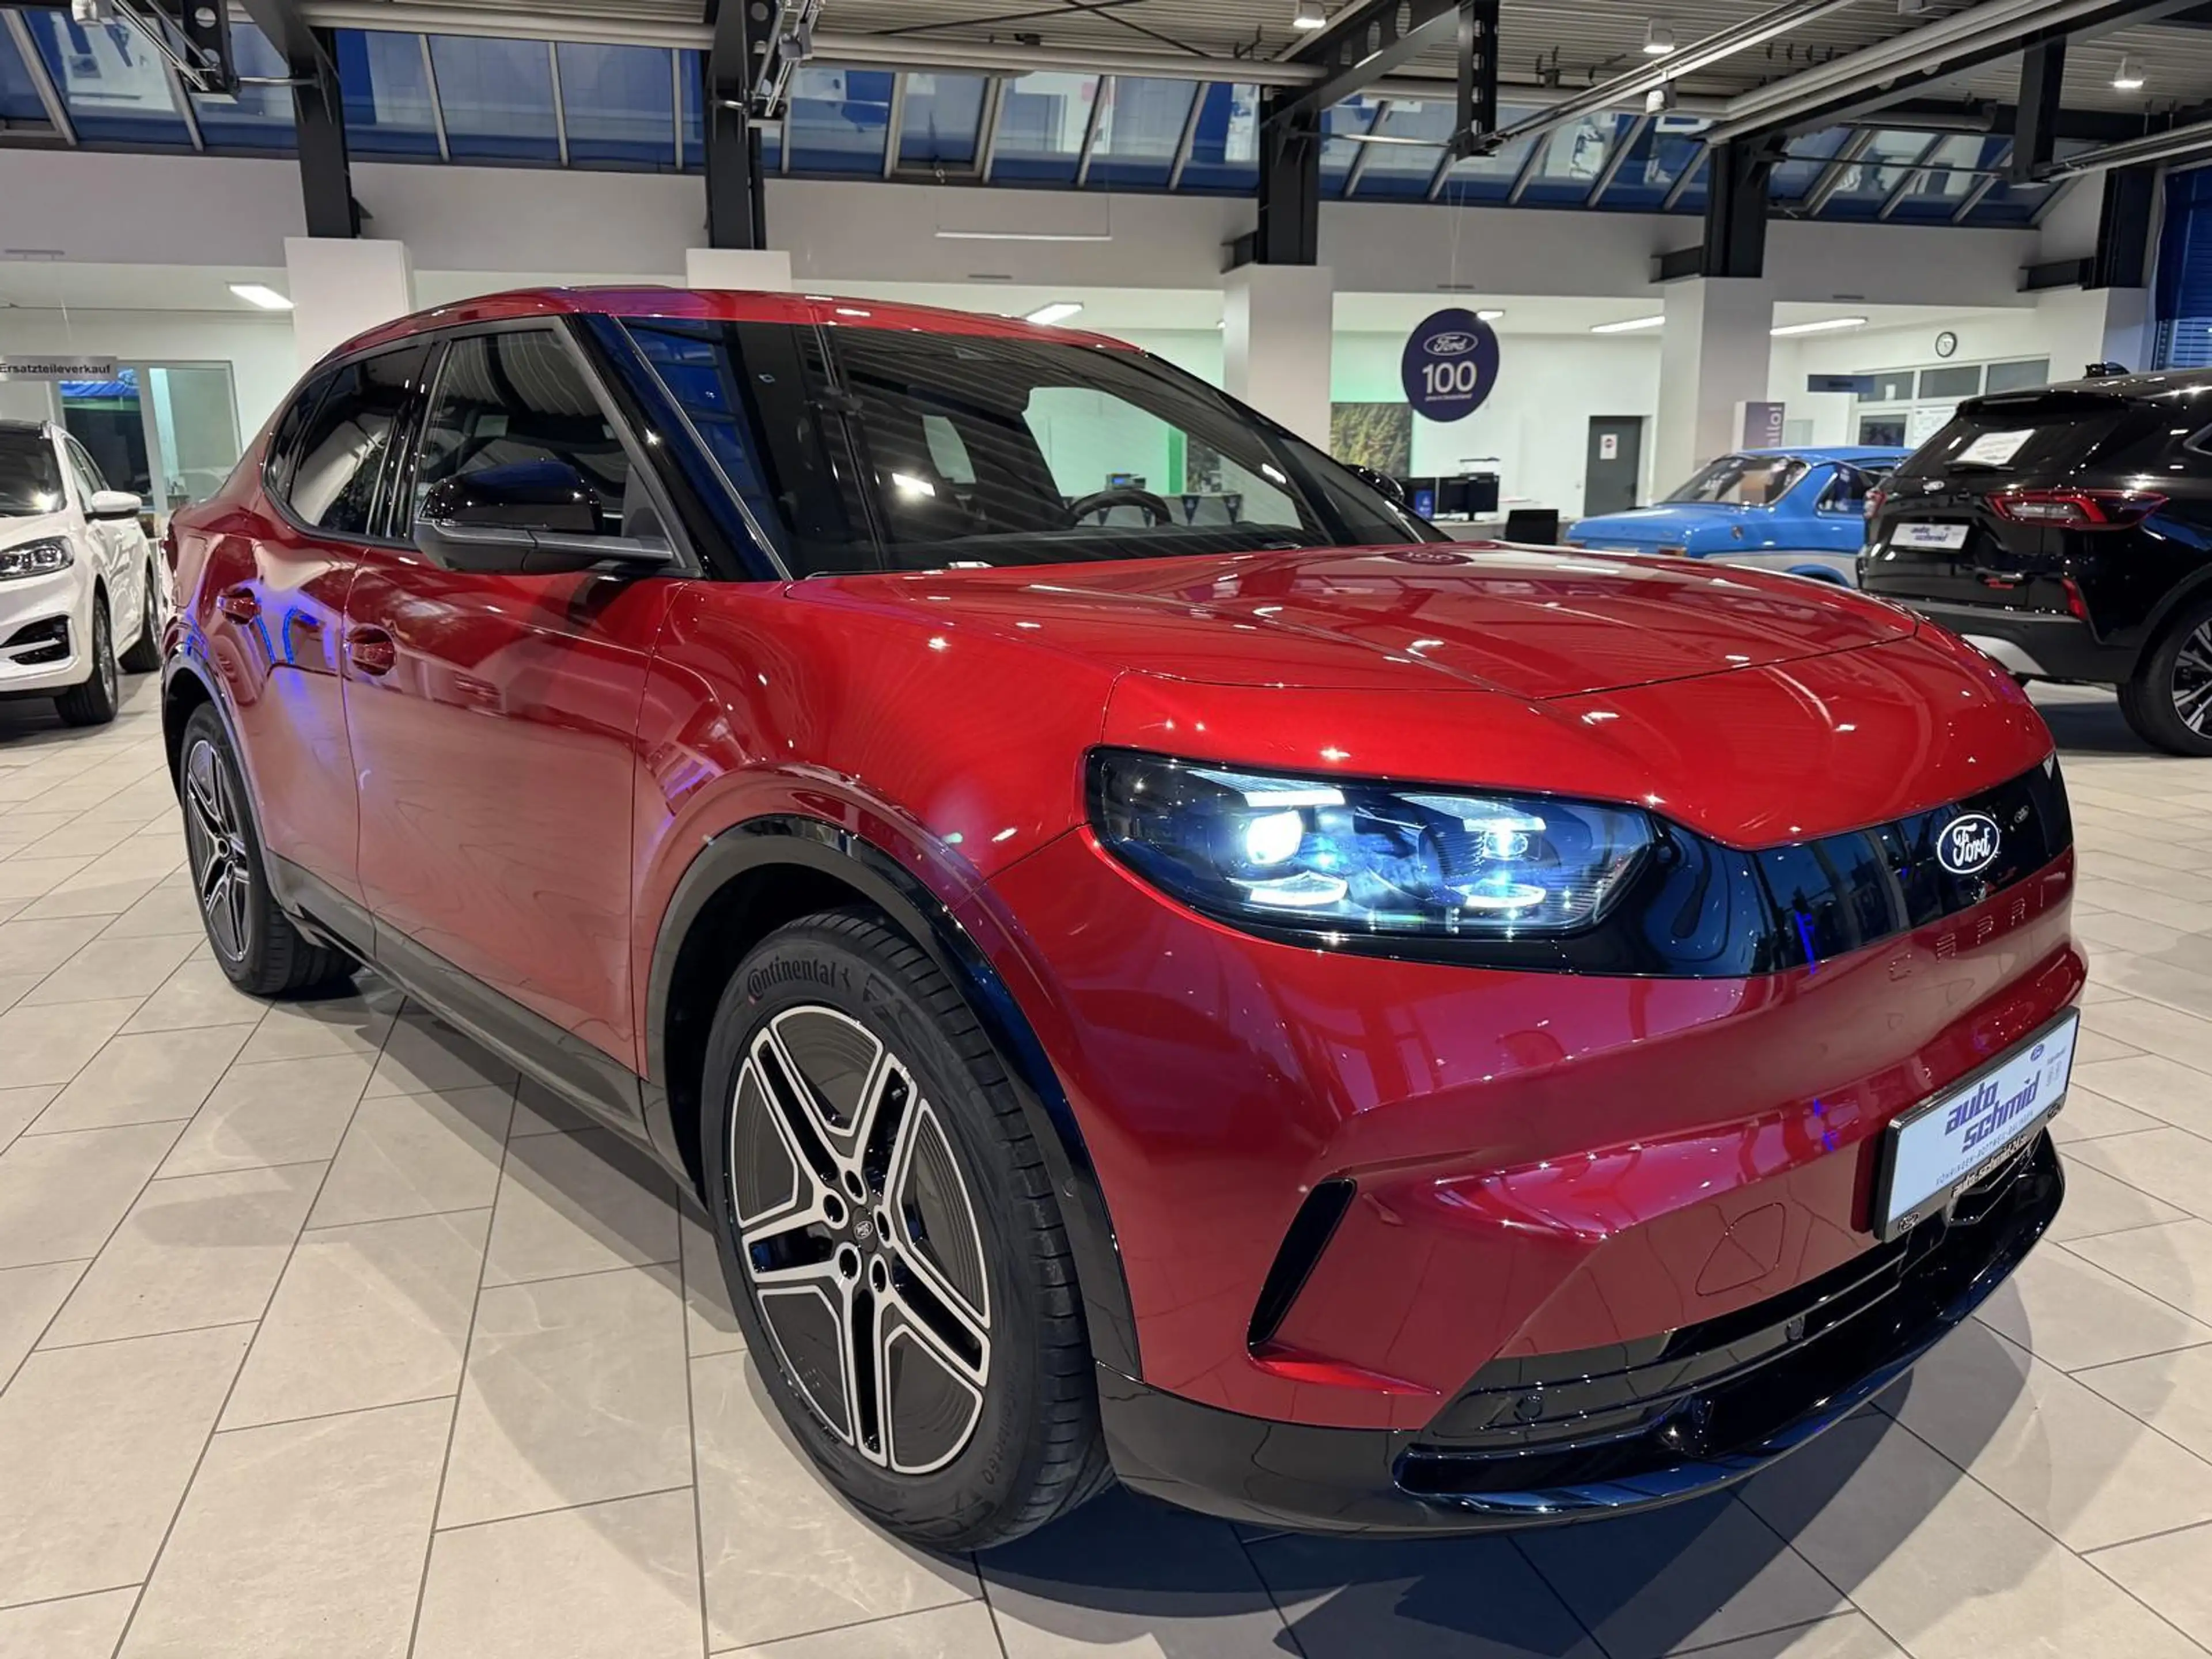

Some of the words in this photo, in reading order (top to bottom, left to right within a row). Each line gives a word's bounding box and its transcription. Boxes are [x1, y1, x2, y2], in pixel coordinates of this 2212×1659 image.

[0, 363, 111, 374] Ersatzteileverkauf
[1422, 360, 1478, 394] 100
[1765, 407, 1782, 448] allo!
[1952, 822, 1991, 867] Ford
[748, 956, 836, 1002] Continental
[1945, 1081, 1999, 1136] auto
[1962, 1069, 2041, 1153] schmid
